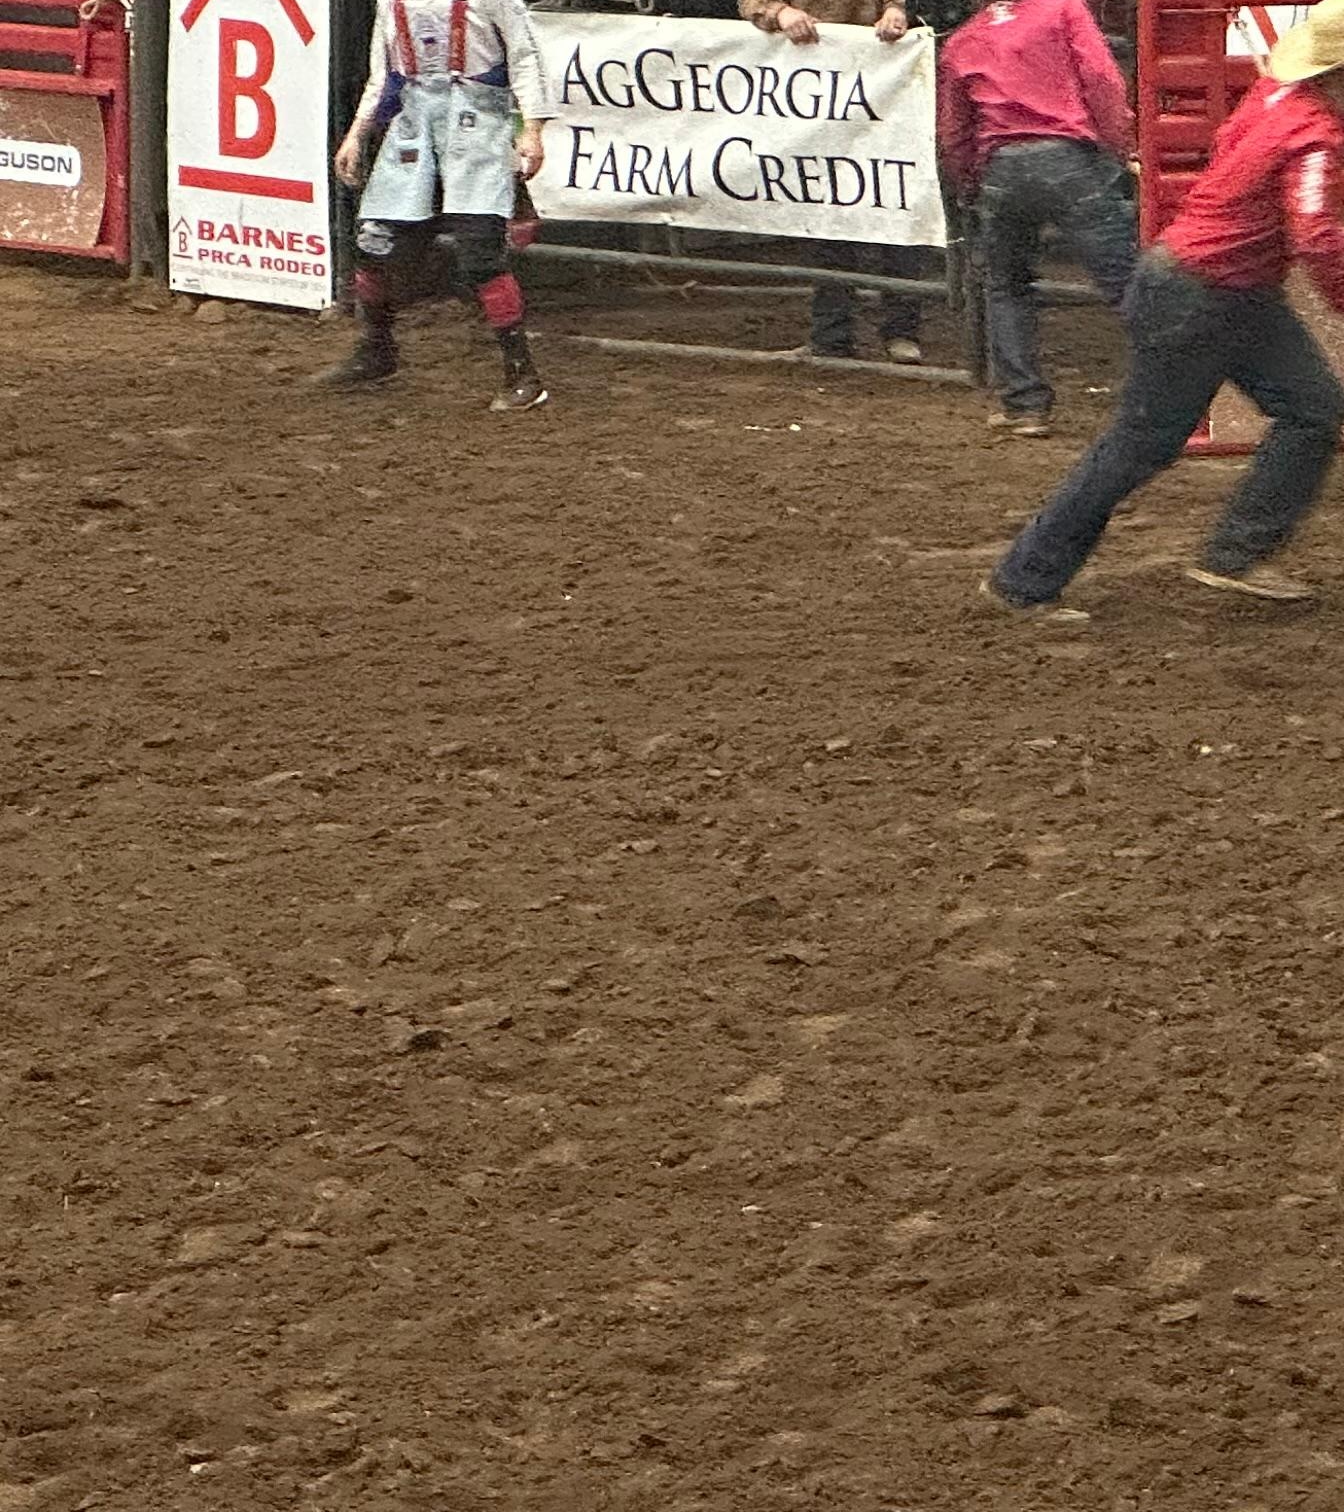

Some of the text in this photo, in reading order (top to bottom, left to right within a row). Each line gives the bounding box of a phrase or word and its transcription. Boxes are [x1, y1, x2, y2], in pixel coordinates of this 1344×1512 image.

[218, 17, 278, 160] B
[566, 124, 917, 212] FARM CREDIT
[178, 231, 188, 253] B
[197, 219, 327, 256] BARNES
[197, 248, 252, 268] PRCA
[260, 256, 326, 277] RODEO
